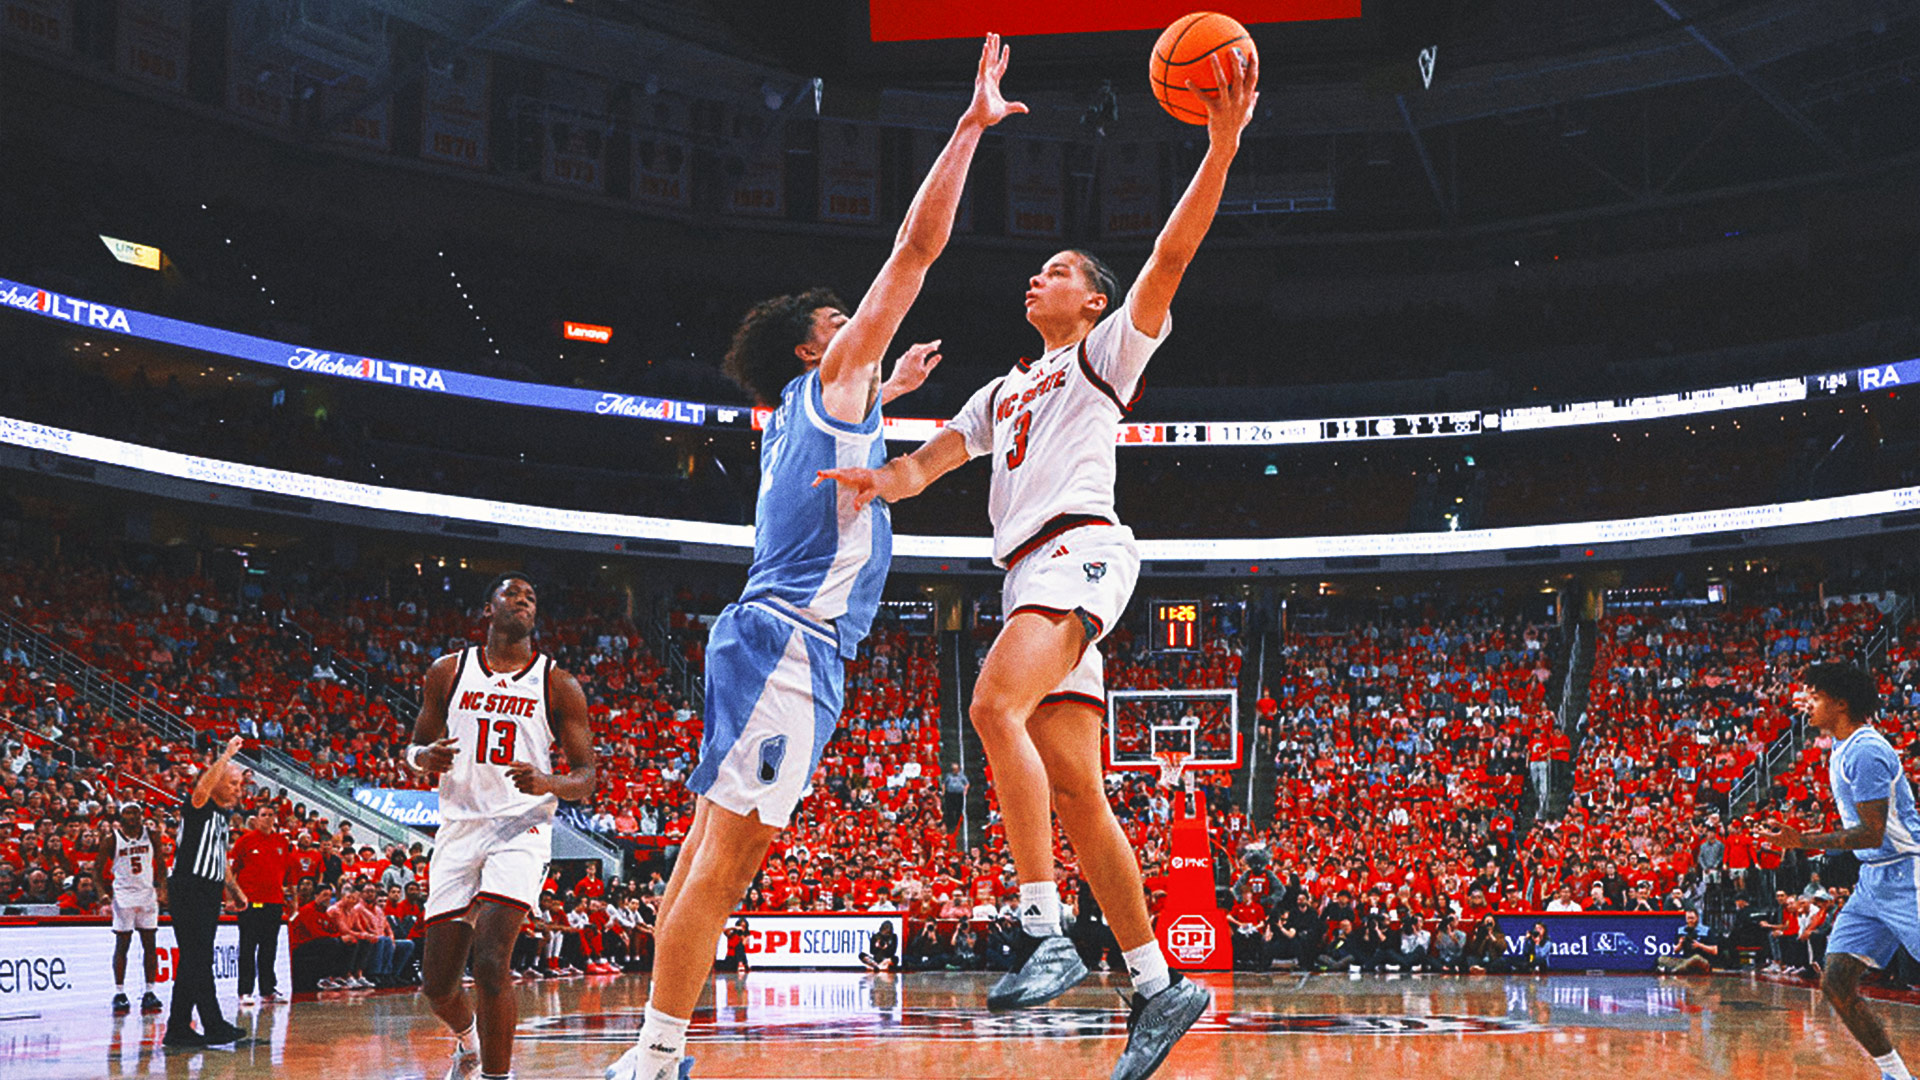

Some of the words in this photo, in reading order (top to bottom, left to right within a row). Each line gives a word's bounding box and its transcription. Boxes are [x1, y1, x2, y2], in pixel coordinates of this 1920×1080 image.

[567, 325, 608, 340] Lenovo
[1006, 410, 1032, 471] 3
[1159, 605, 1196, 622] 11:26
[1167, 622, 1194, 648] 11
[458, 691, 485, 711] NC
[484, 694, 540, 718] STATE
[475, 718, 517, 765] 13
[130, 857, 142, 875] 5
[744, 931, 799, 954] CPI
[1172, 931, 1210, 947] CPI
[1503, 935, 1587, 955] Mael
